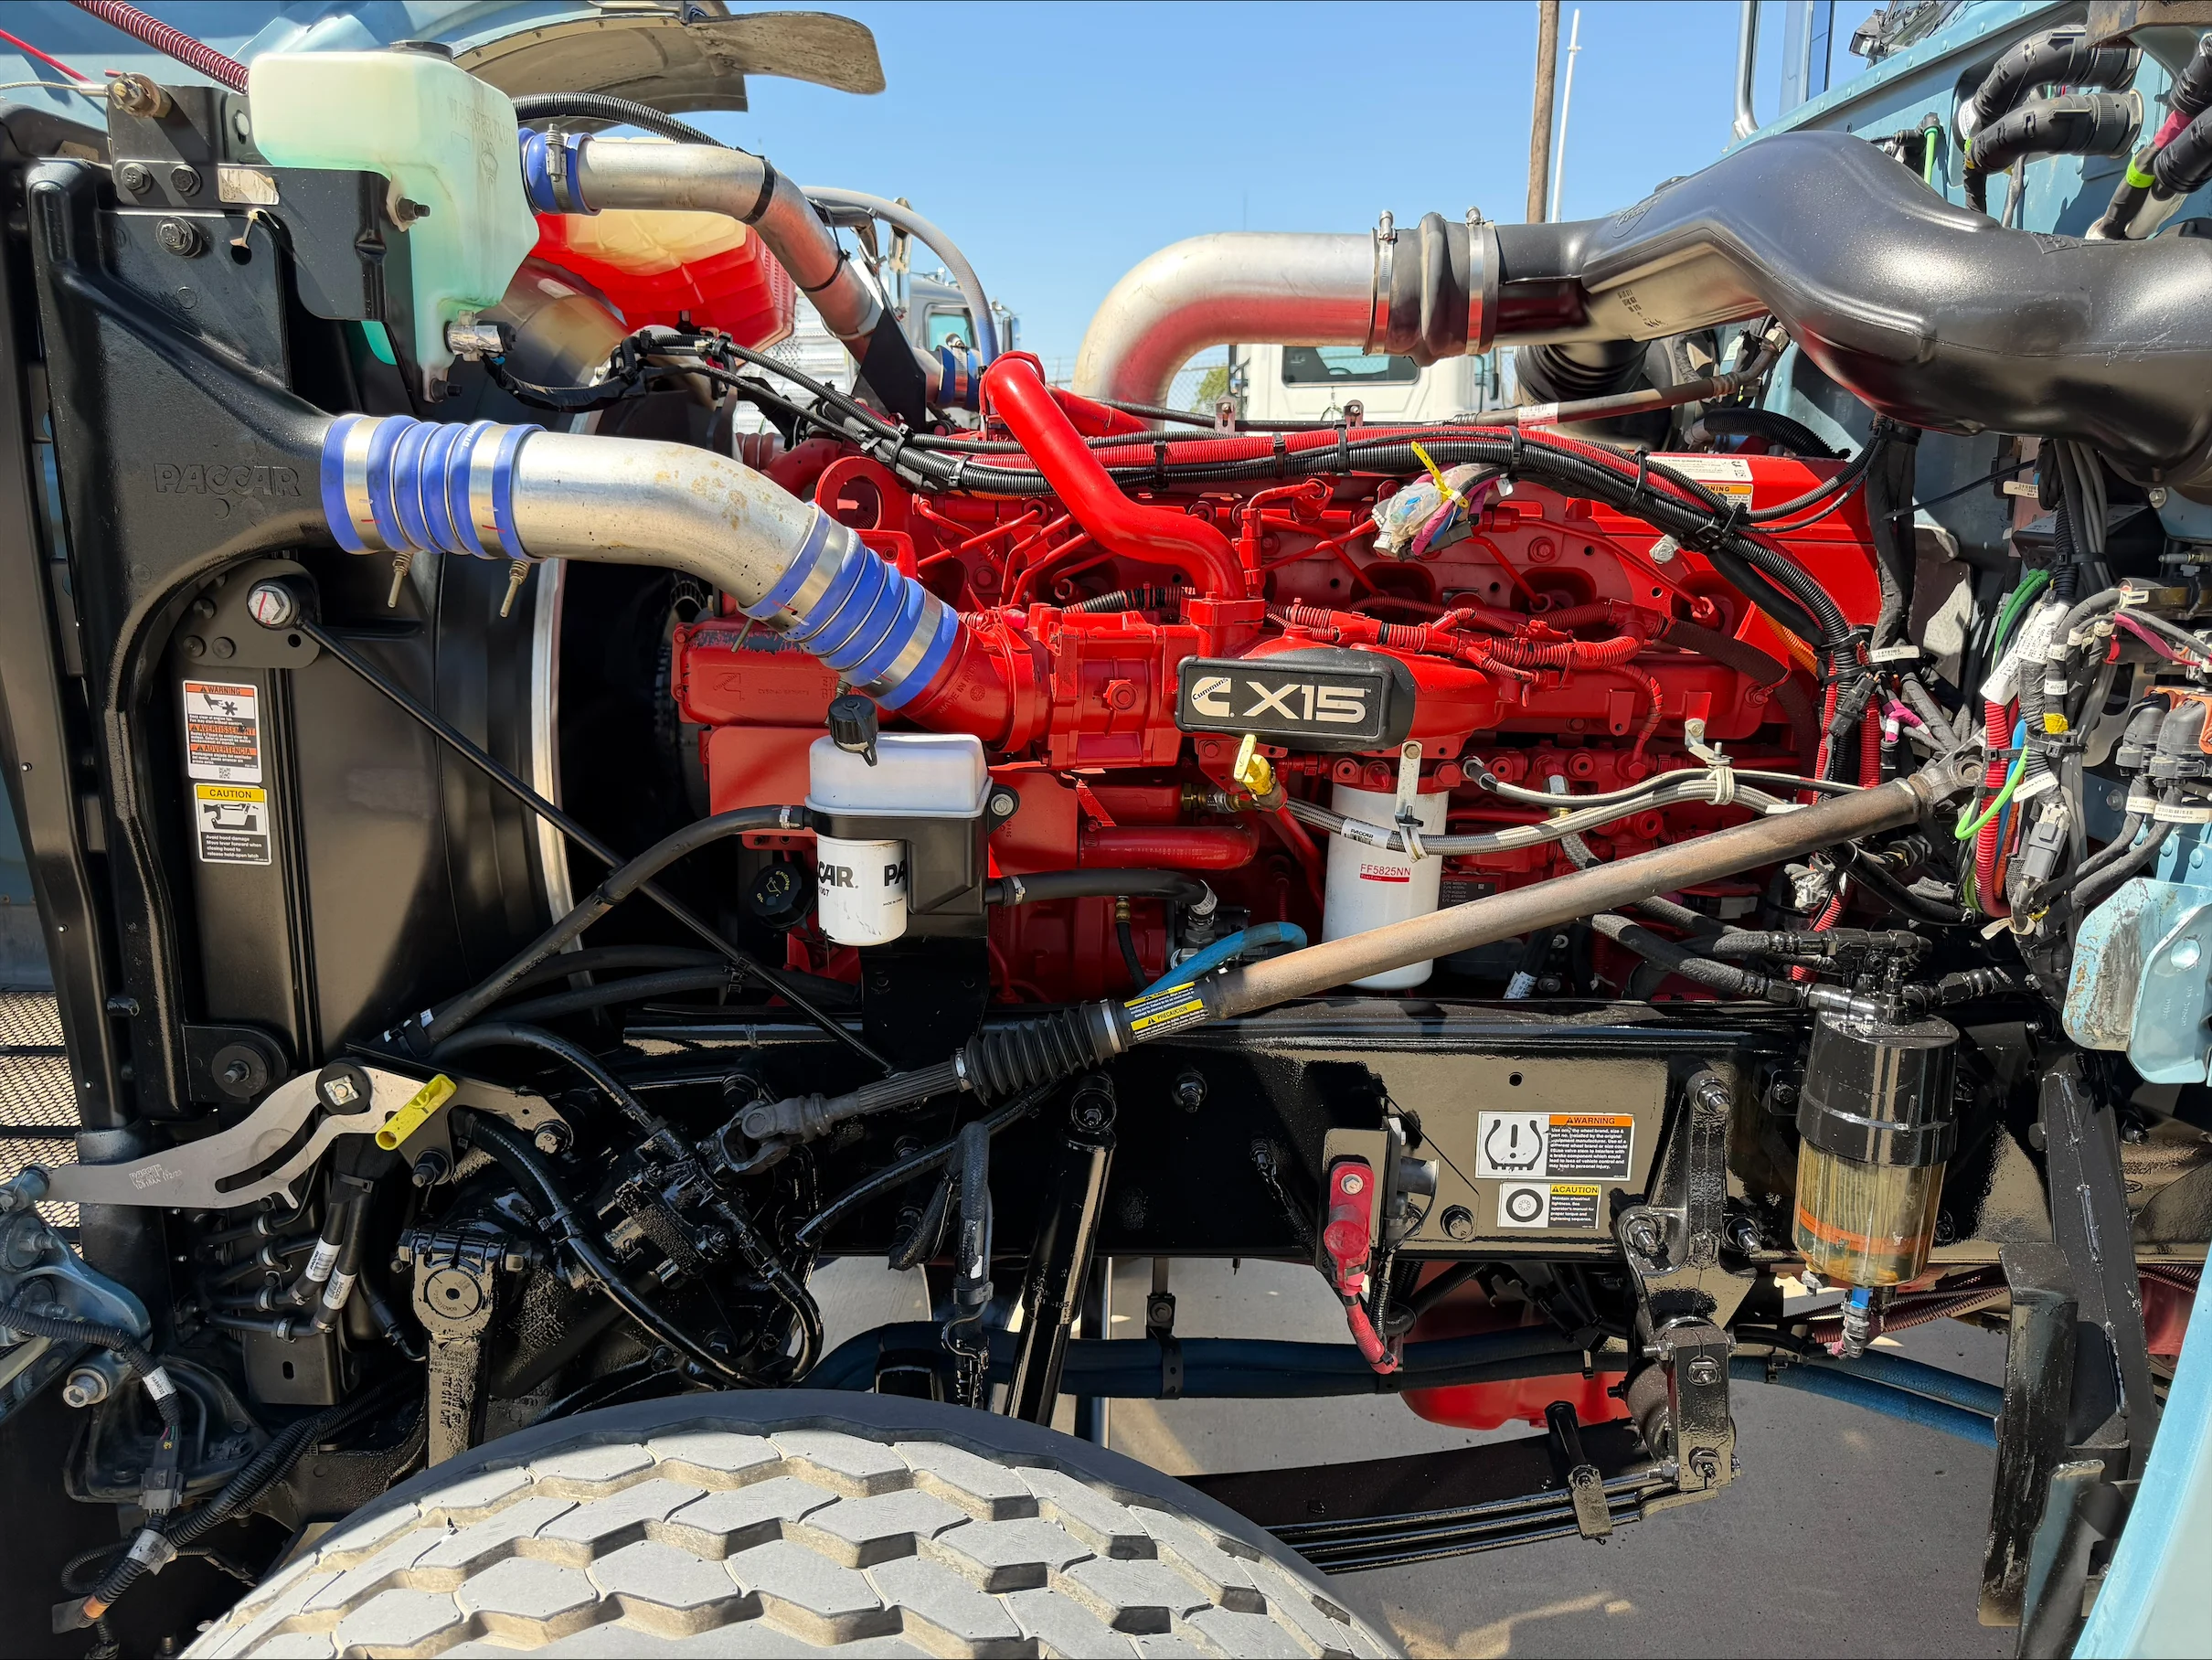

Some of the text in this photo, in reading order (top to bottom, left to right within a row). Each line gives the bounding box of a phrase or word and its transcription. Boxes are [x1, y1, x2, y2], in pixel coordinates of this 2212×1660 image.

[154, 463, 302, 496] PACCAR
[1707, 484, 1730, 493] NING
[208, 686, 240, 695] WARNING
[938, 660, 979, 713] MADE IN INDIA
[1192, 677, 1228, 700] Cummins
[1242, 681, 1367, 723] X15
[205, 746, 250, 754] ADVERTENCIA
[209, 790, 251, 798] CAUTION
[1351, 829, 1373, 838] PACCAR
[1360, 864, 1411, 876] FF5825NN
[775, 870, 790, 890] ENGINE
[1156, 1006, 1186, 1019] PRECAUCION
[151, 1376, 165, 1394] HARNESS
